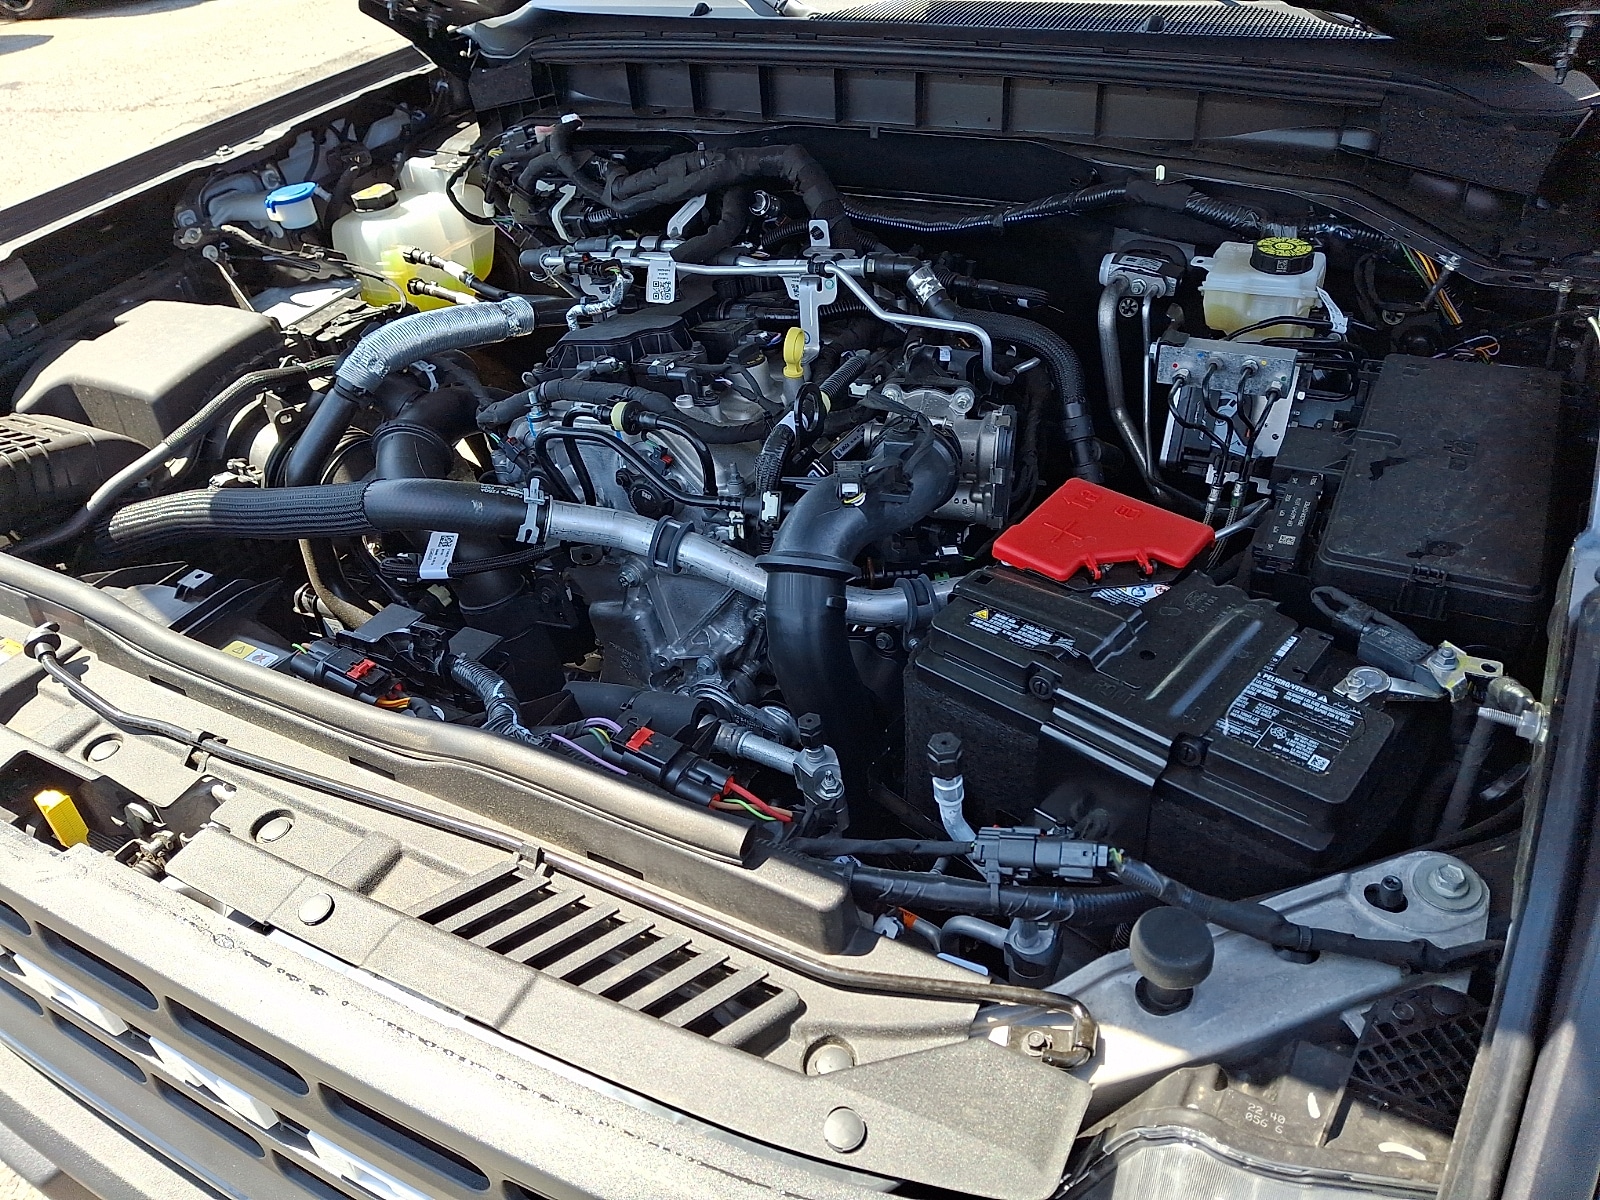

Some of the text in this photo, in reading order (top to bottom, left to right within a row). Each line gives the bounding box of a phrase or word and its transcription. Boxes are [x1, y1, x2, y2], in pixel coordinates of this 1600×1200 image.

[1262, 672, 1317, 698] PELIGRO/VENENO
[1245, 1112, 1284, 1134] 056 6
